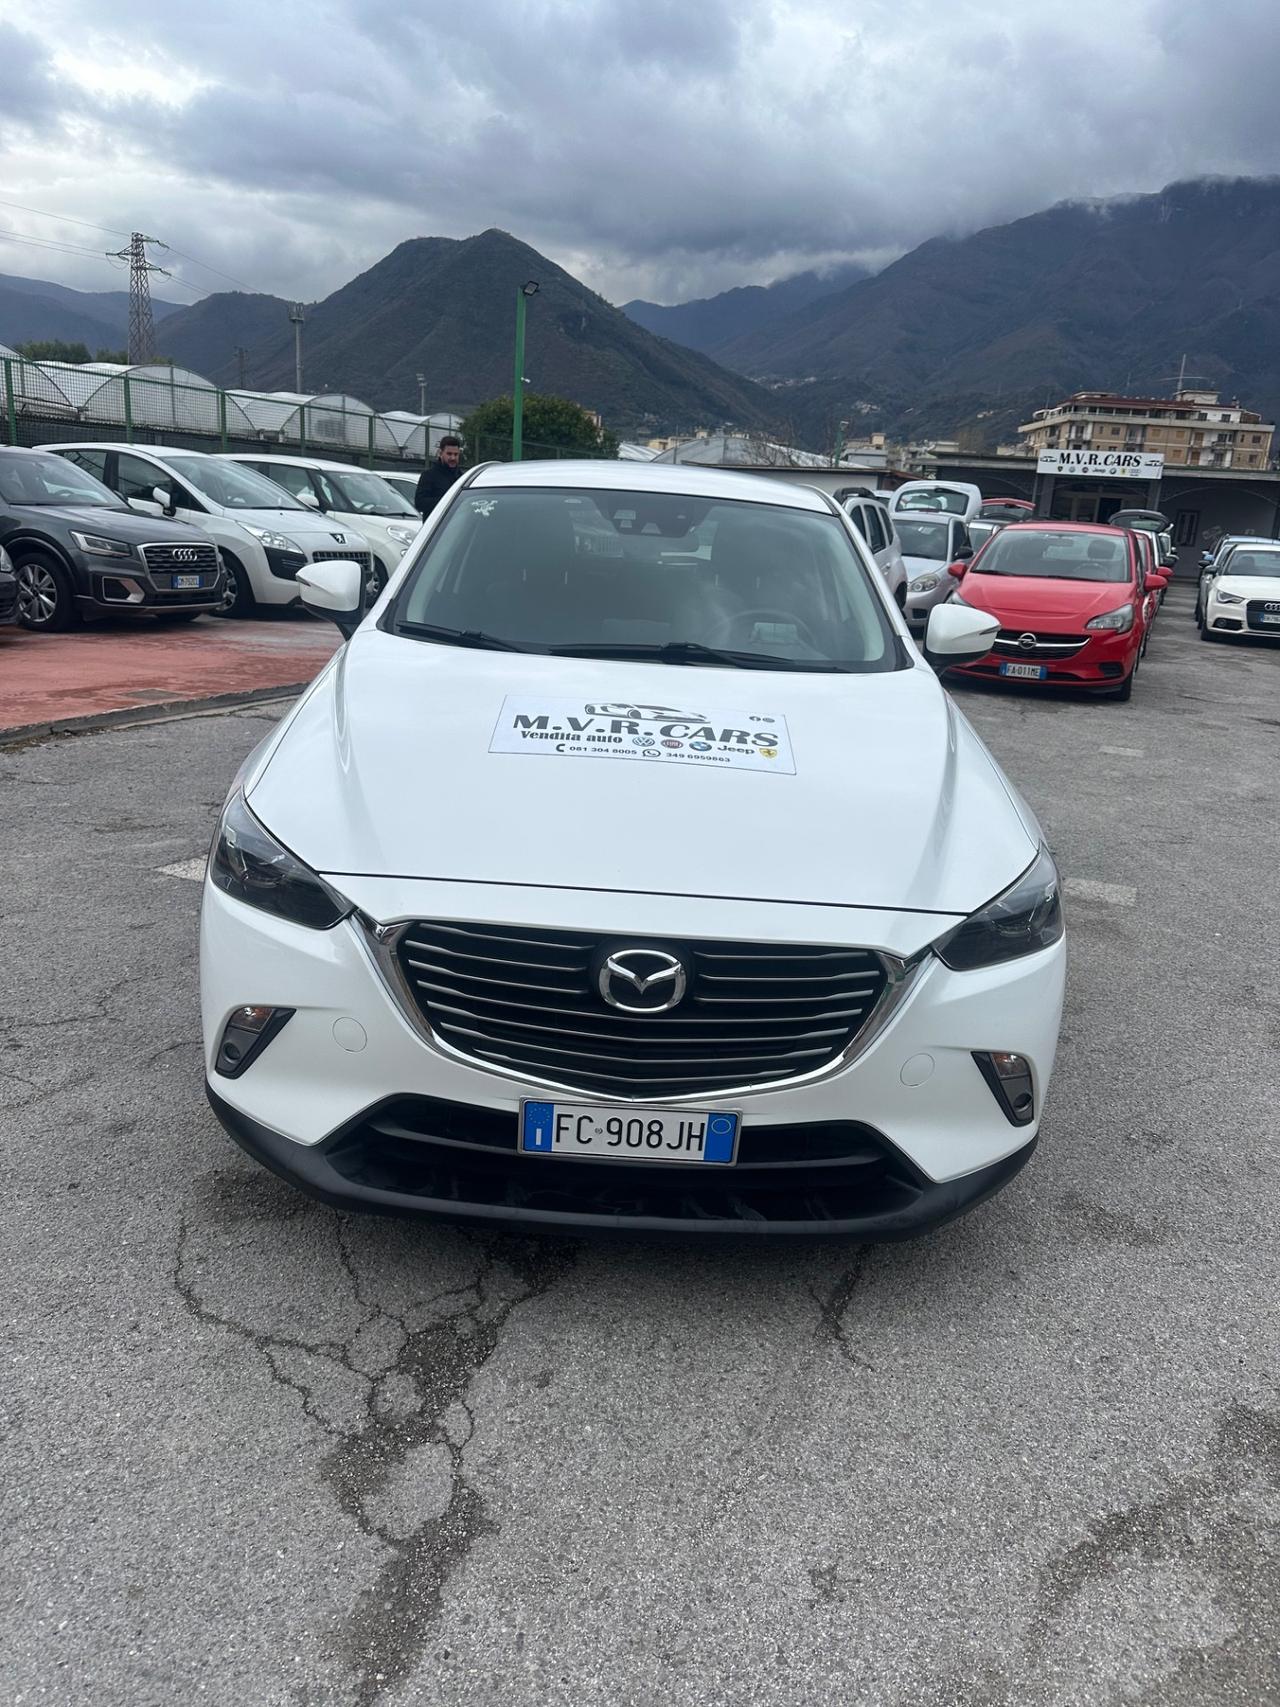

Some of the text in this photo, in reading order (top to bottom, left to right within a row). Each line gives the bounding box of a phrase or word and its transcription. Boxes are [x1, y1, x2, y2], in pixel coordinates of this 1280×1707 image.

[521, 730, 623, 744] Vendita auto
[717, 745, 755, 755] Jeep
[555, 1113, 705, 1151] FC 908JH
